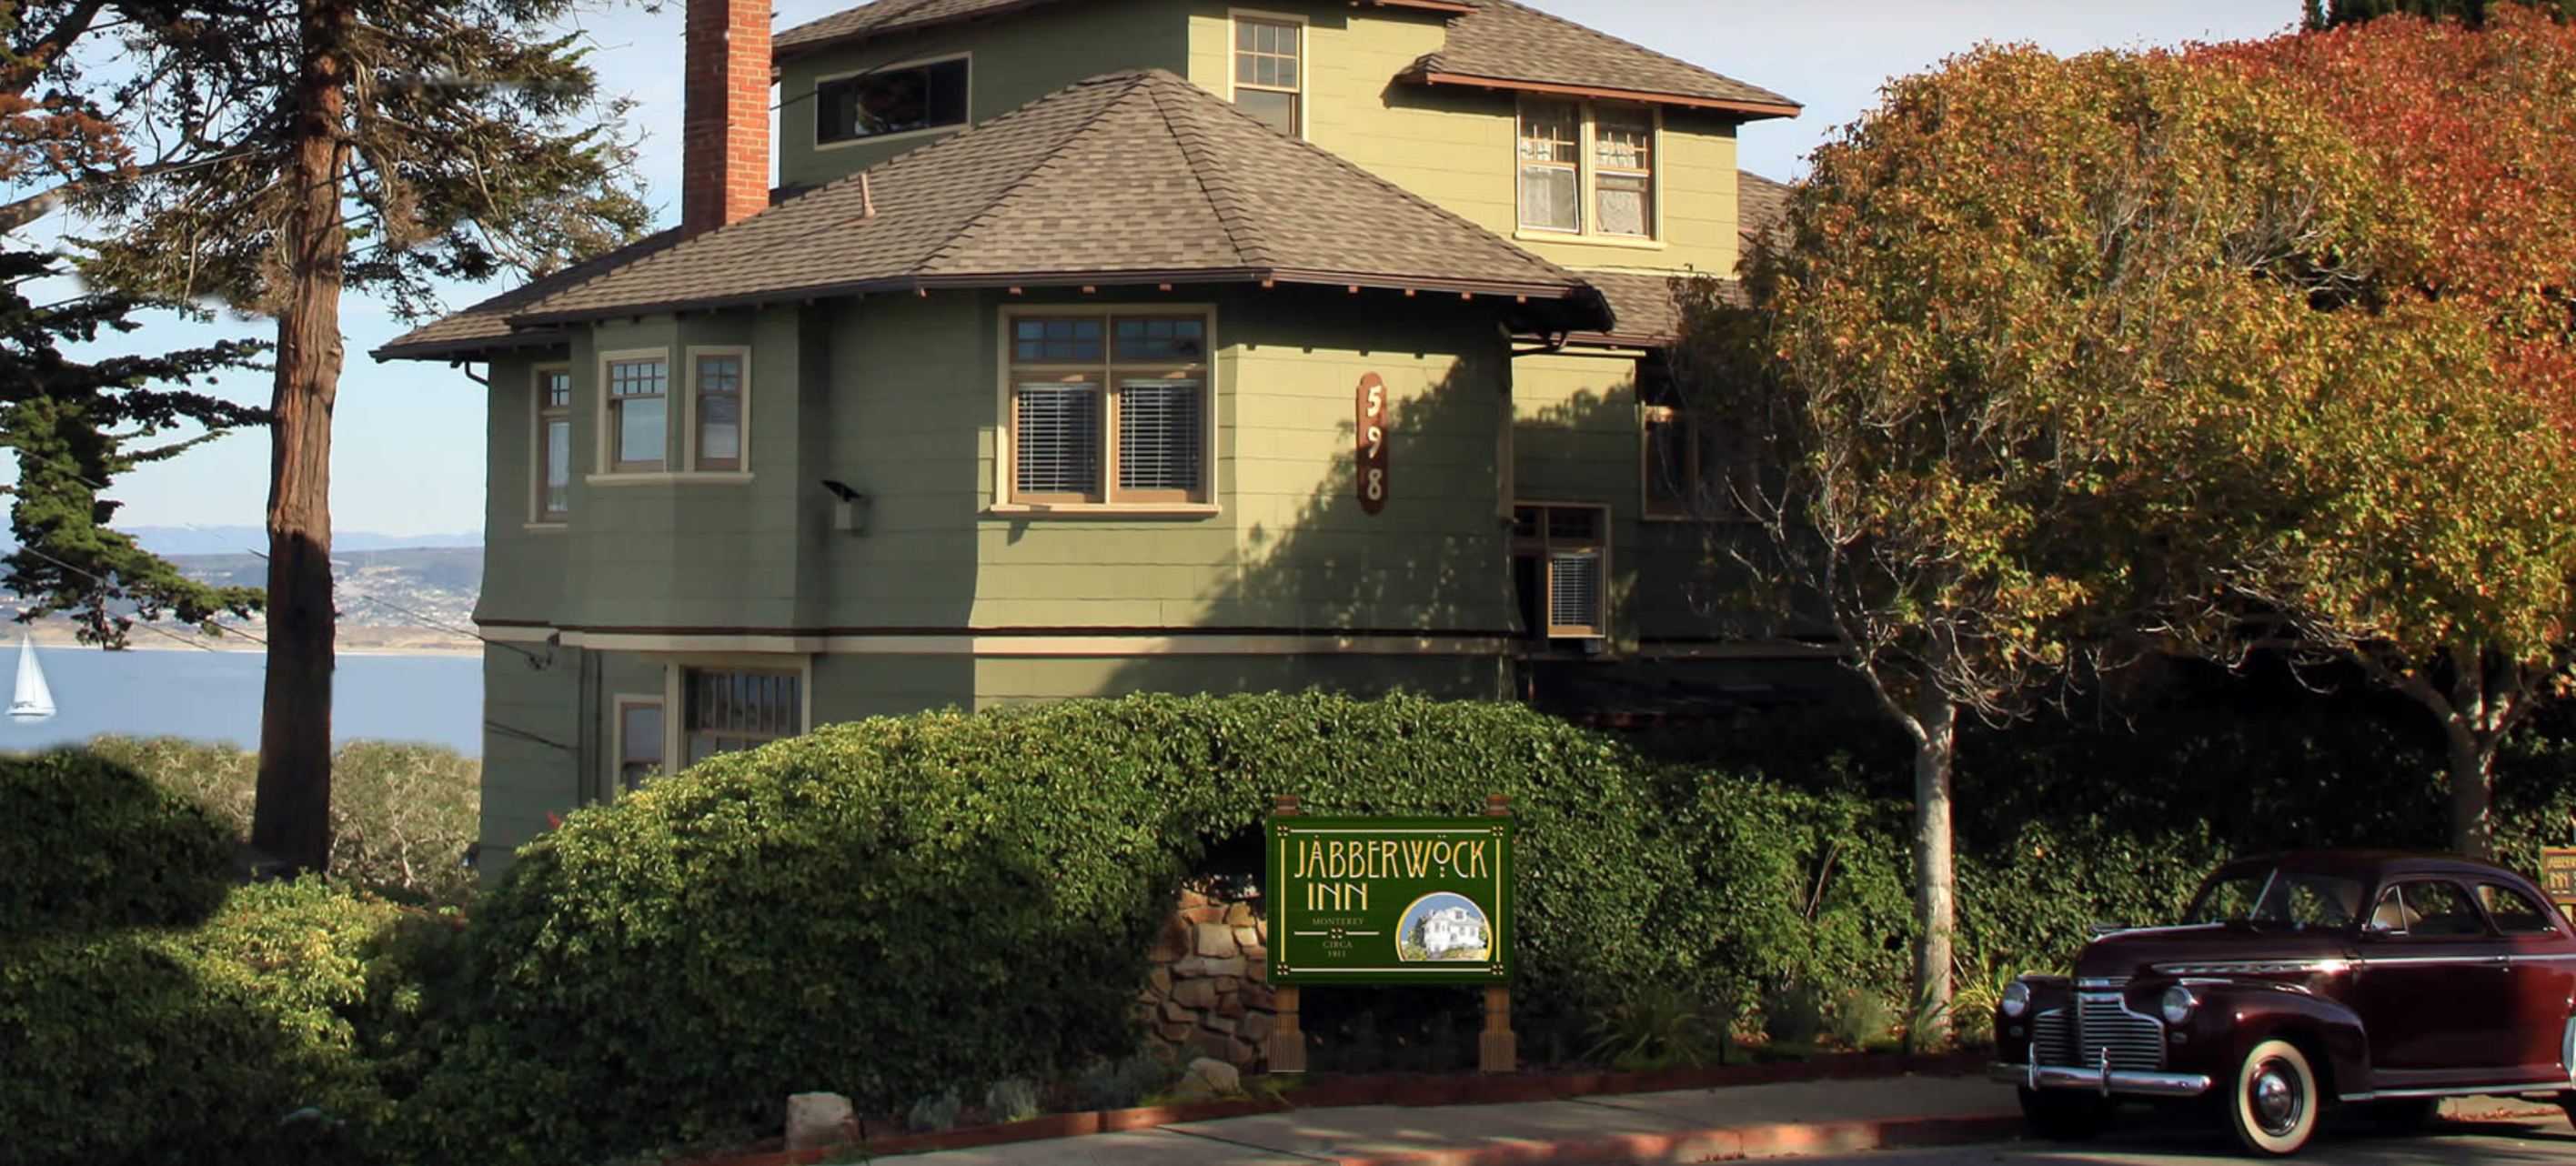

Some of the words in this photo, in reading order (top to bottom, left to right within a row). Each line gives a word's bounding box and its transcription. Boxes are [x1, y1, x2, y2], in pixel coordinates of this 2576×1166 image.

[1366, 385, 1382, 500] 598
[1308, 882, 1367, 910] INN
[1312, 918, 1364, 926] MONTEREY
[1323, 940, 1353, 949] CIRCA
